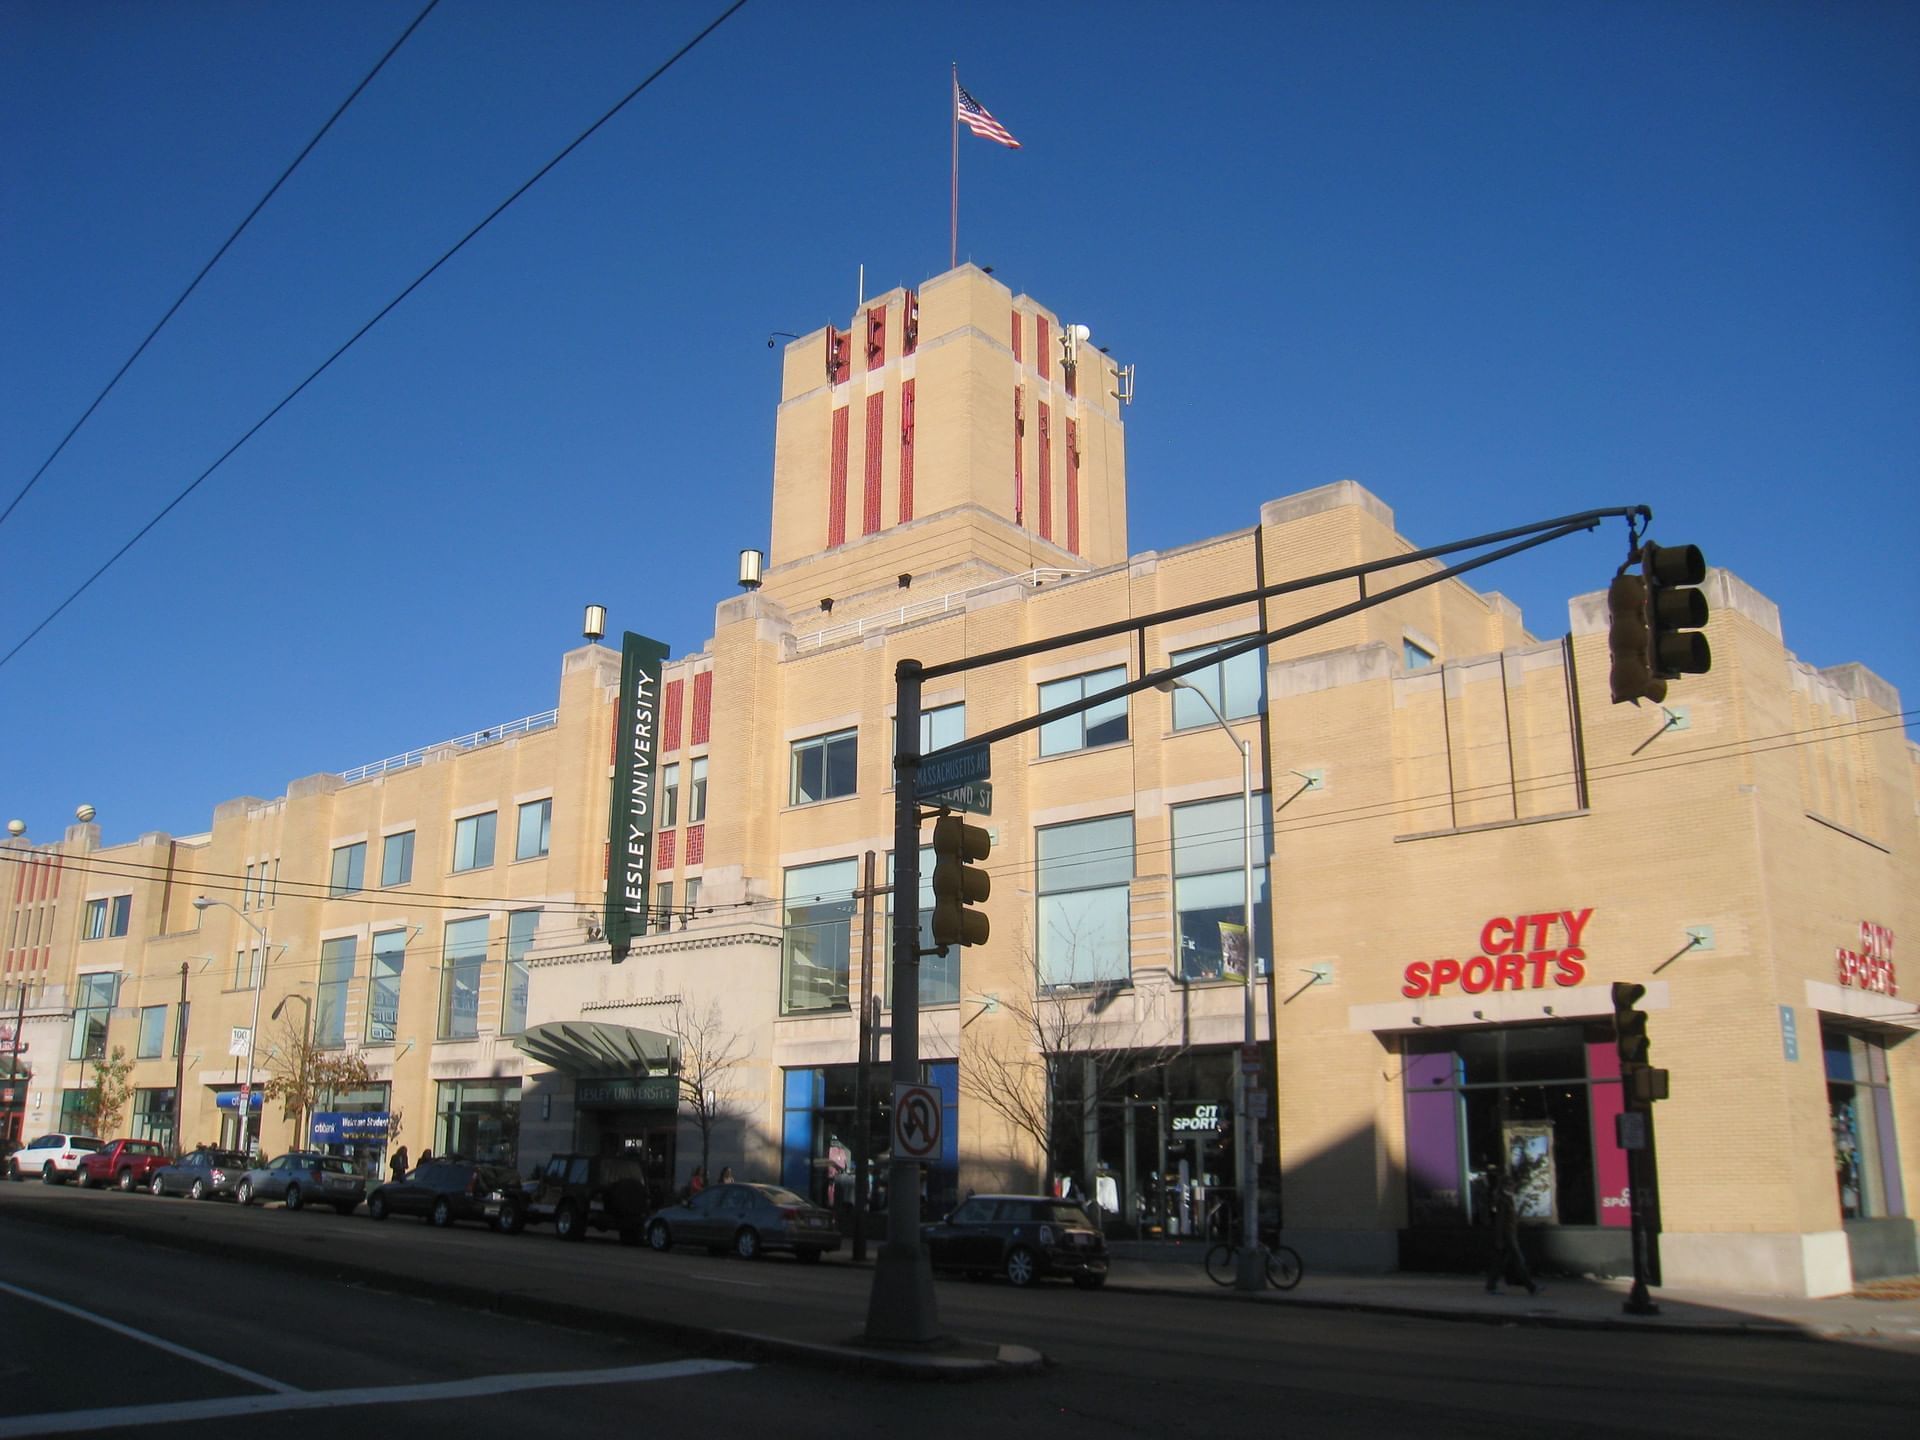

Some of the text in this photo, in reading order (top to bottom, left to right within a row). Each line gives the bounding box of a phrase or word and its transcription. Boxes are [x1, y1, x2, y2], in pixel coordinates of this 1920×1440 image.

[917, 755, 975, 785] MASSACHUSETTS
[625, 669, 655, 914] LESLEY UNIVERSITY
[979, 789, 991, 809] ST
[1480, 908, 1594, 956] CITY
[1859, 921, 1894, 962] CITY
[1402, 947, 1587, 999] SPORTS
[1836, 948, 1898, 998] SPORTS
[579, 1087, 608, 1101] LESLEY
[314, 1122, 336, 1133] citibank
